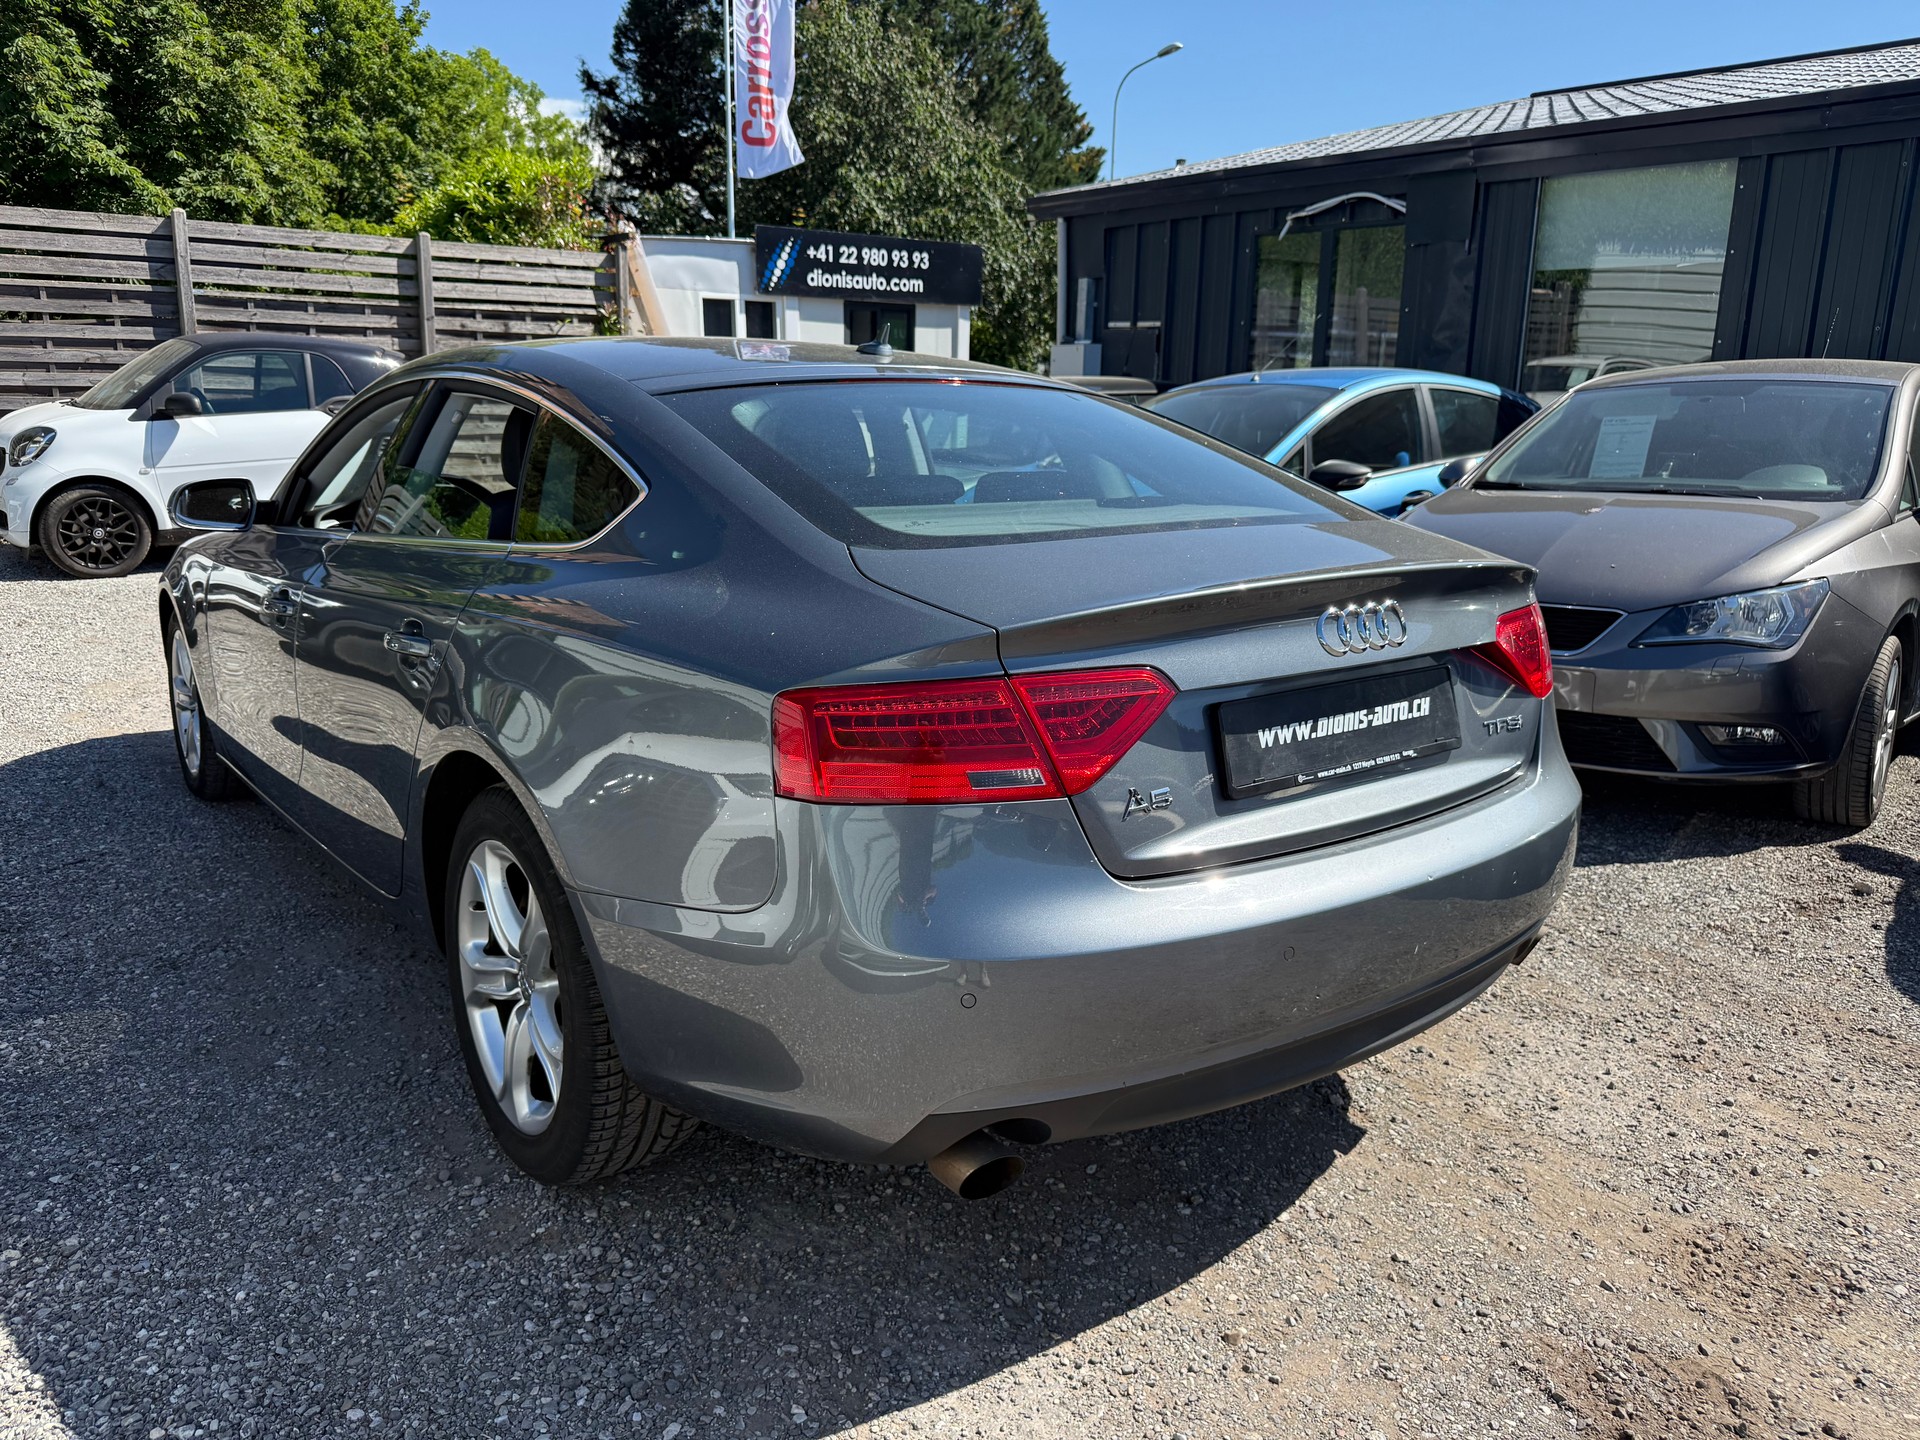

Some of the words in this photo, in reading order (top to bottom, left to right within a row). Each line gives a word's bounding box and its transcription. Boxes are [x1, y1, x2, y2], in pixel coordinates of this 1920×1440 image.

[806, 243, 834, 263] +41
[839, 245, 858, 264] 22
[861, 247, 889, 267] 980
[891, 249, 909, 268] 93
[912, 251, 930, 270] 93
[806, 268, 924, 293] dionisauto.com
[1483, 714, 1523, 736] TFSI
[1121, 786, 1173, 822] A5
